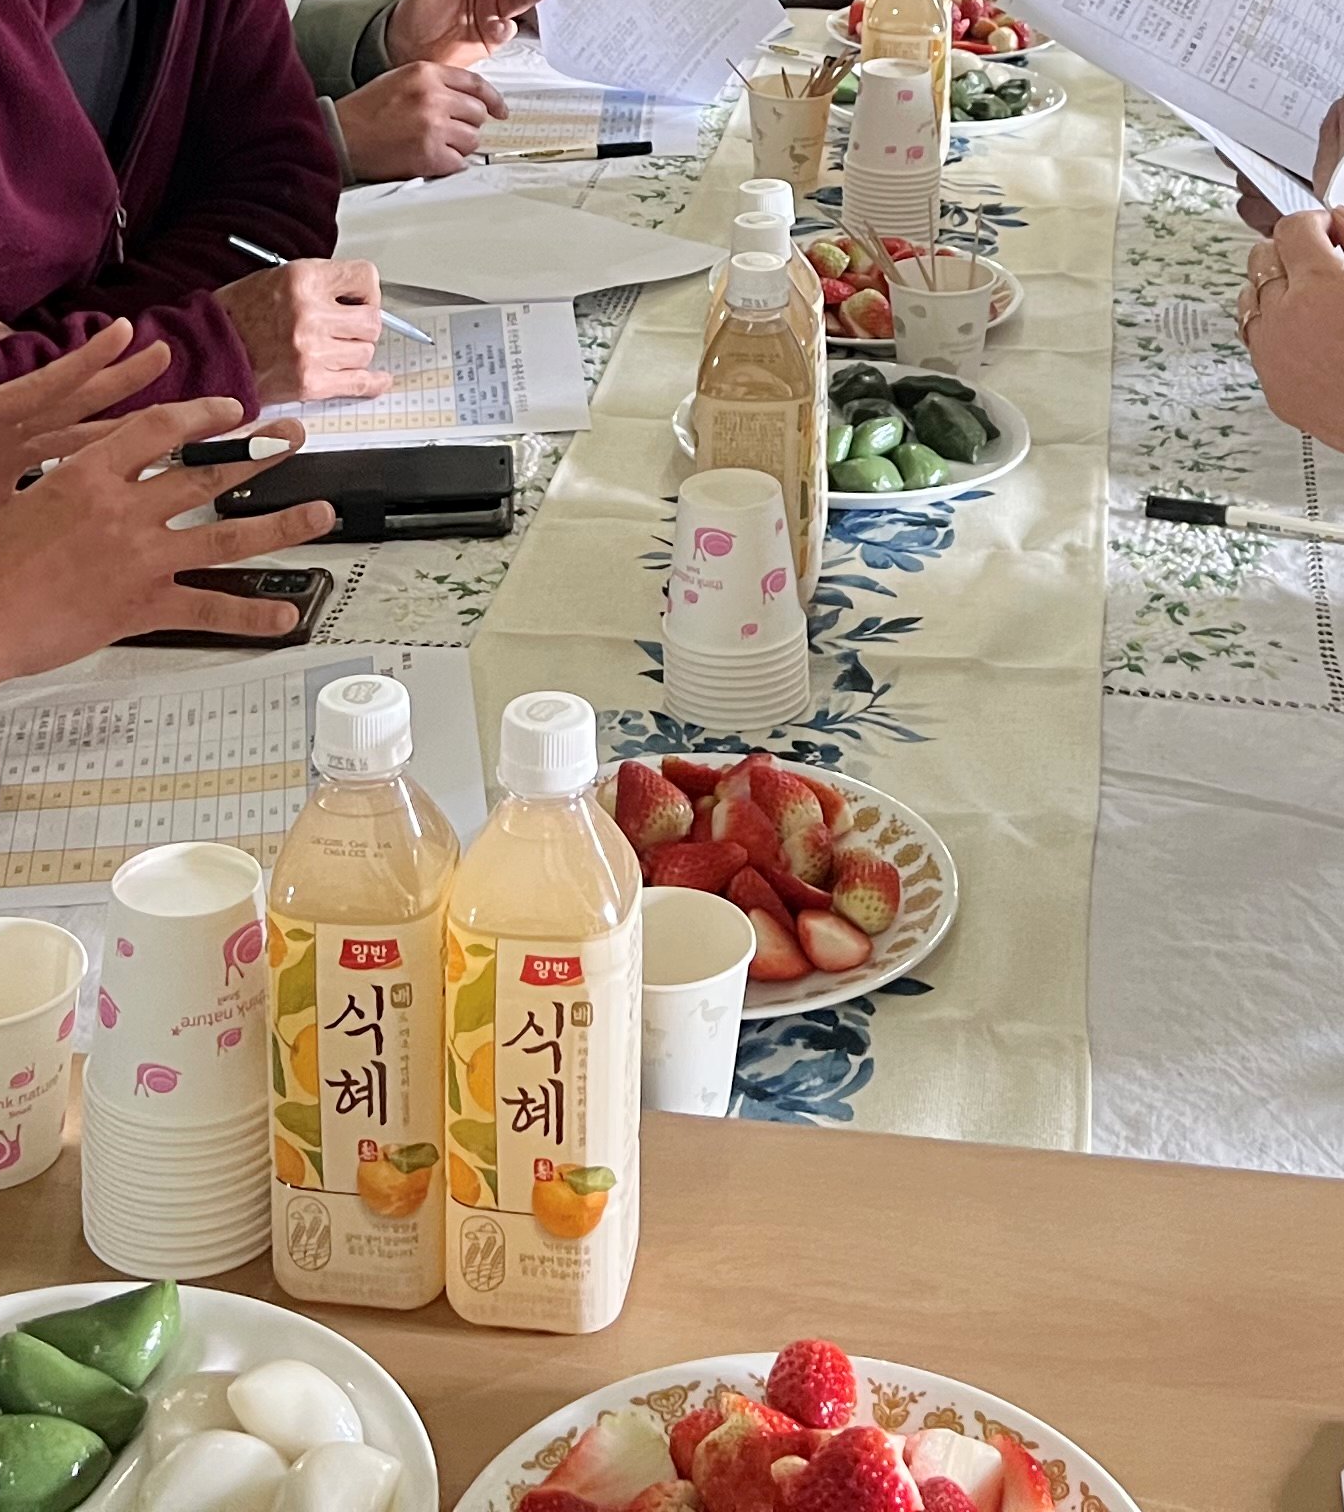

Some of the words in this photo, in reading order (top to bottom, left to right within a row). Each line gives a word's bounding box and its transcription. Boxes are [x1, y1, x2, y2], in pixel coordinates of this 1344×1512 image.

[352, 944, 388, 964] 양반
[534, 960, 570, 979] 양반
[180, 1007, 233, 1028] nature
[324, 984, 388, 1126] 식혜
[501, 1001, 564, 1145] 식혜
